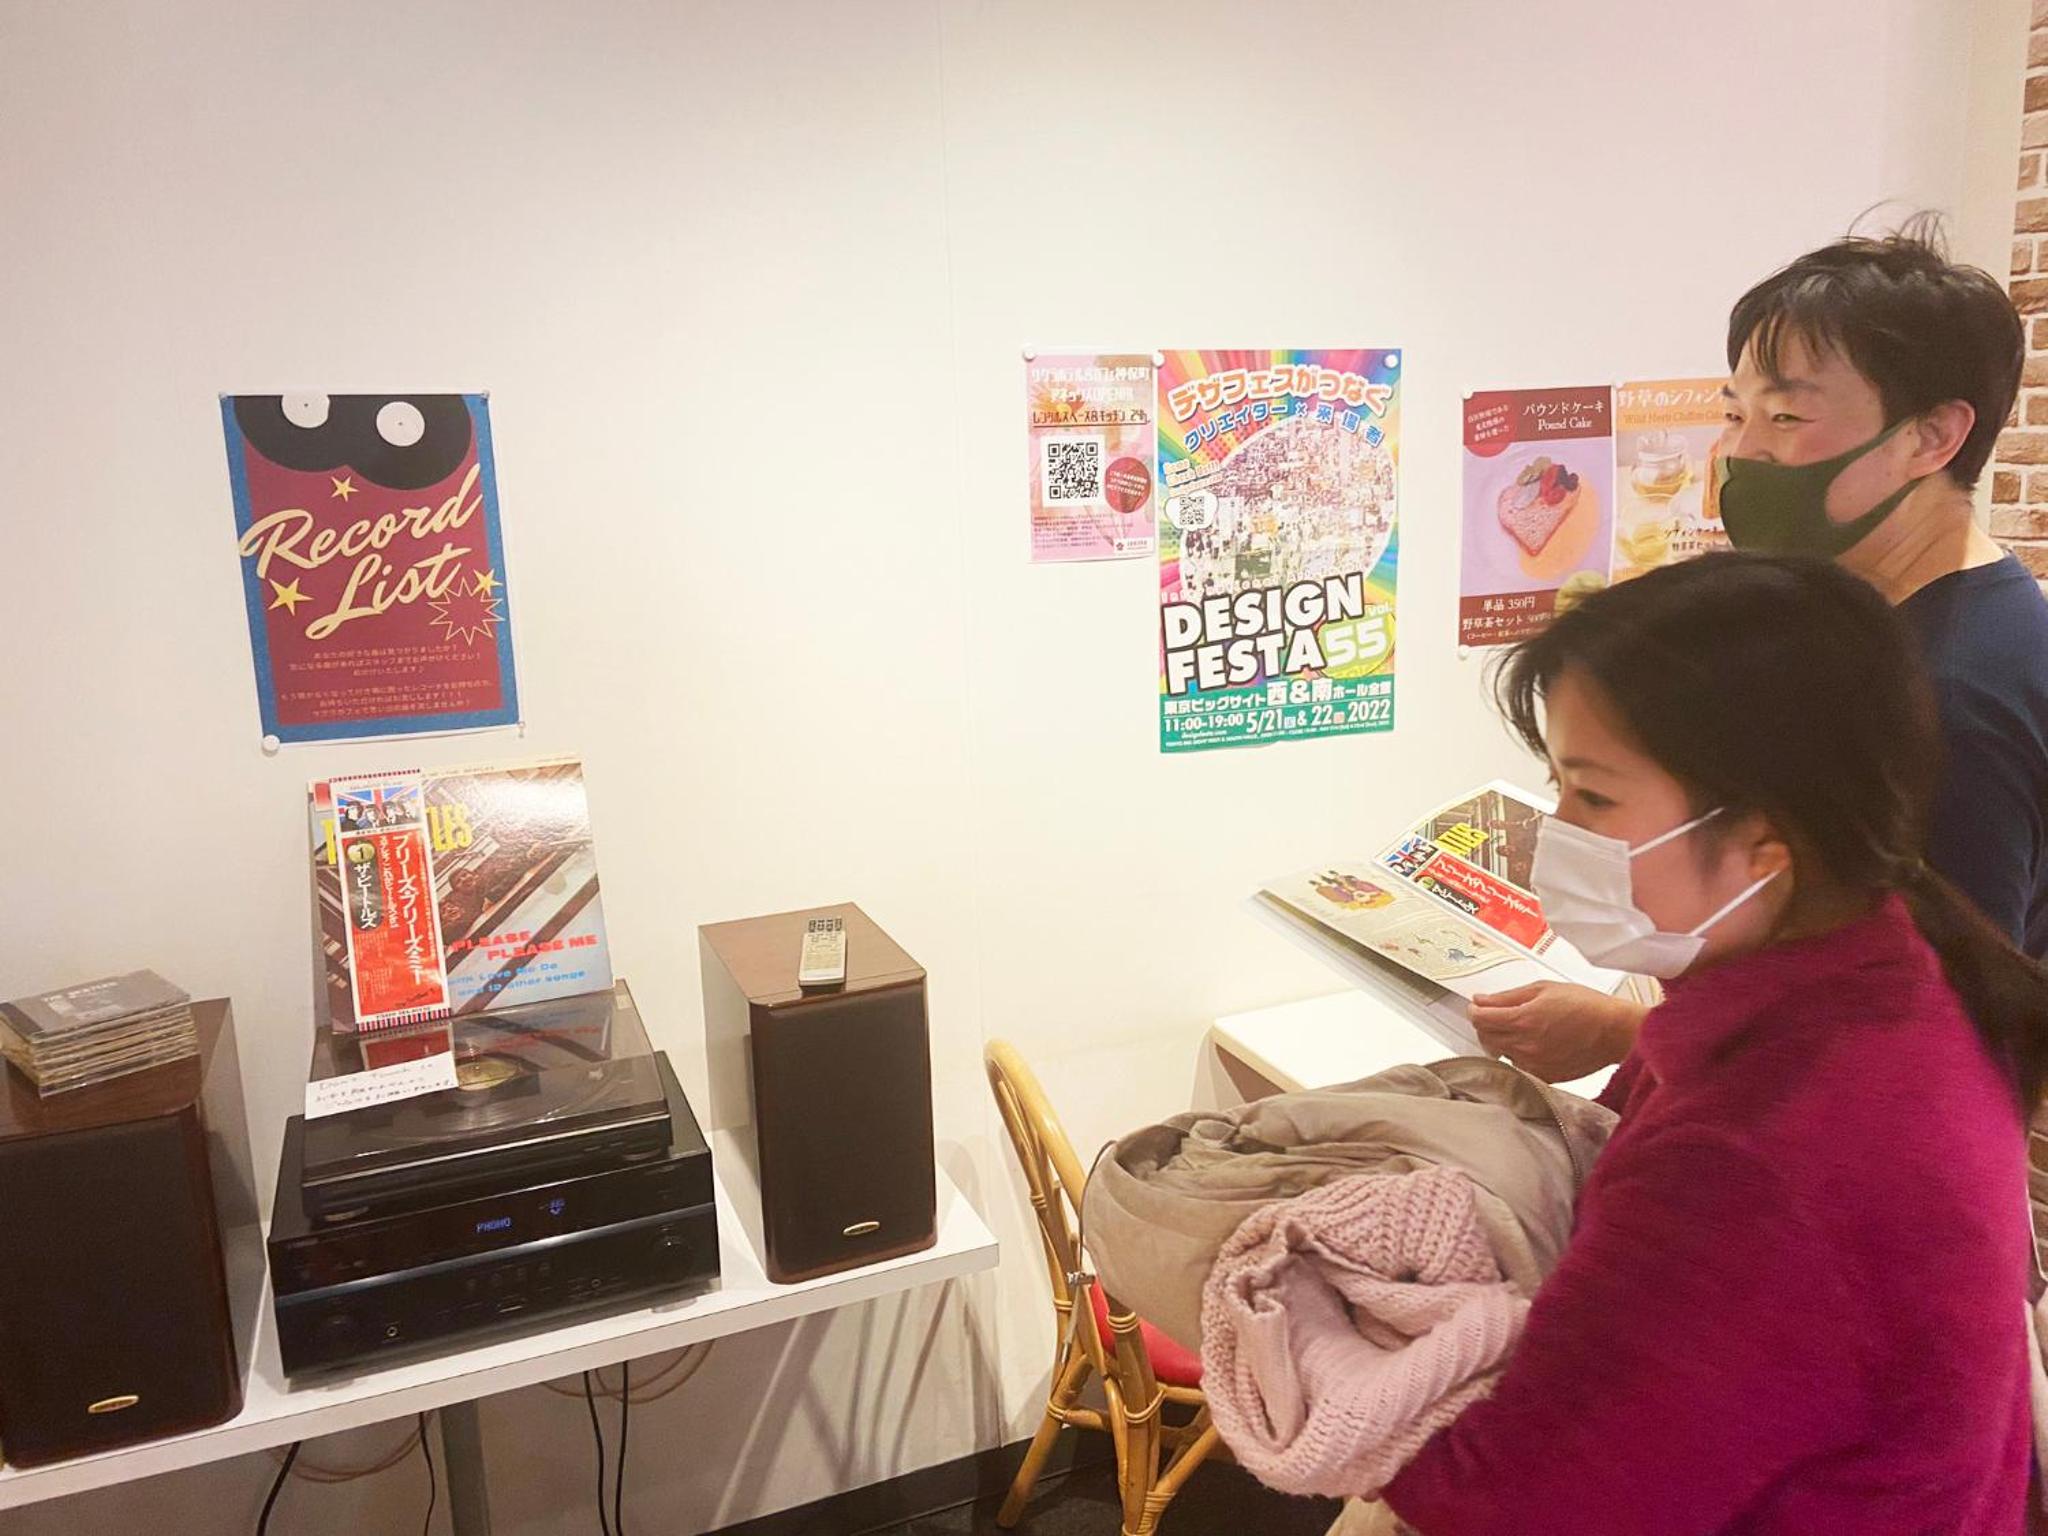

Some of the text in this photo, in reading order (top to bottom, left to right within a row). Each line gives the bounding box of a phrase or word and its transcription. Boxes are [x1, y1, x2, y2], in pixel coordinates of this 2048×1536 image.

[1169, 367, 1392, 421] デザフェスがつなぐ
[1522, 401, 1605, 417] パウンドケーキ
[1538, 417, 1593, 431] Pound Cake
[240, 463, 483, 579] Record
[305, 543, 472, 640] List
[1163, 573, 1364, 649] DESIGN
[1166, 628, 1327, 695] FESTA
[1324, 617, 1388, 667] 55
[1165, 712, 1244, 733] 11:00-19:00
[1348, 698, 1391, 723] 2022
[450, 930, 532, 952] PLEASE
[487, 934, 598, 961] PLEASE ME
